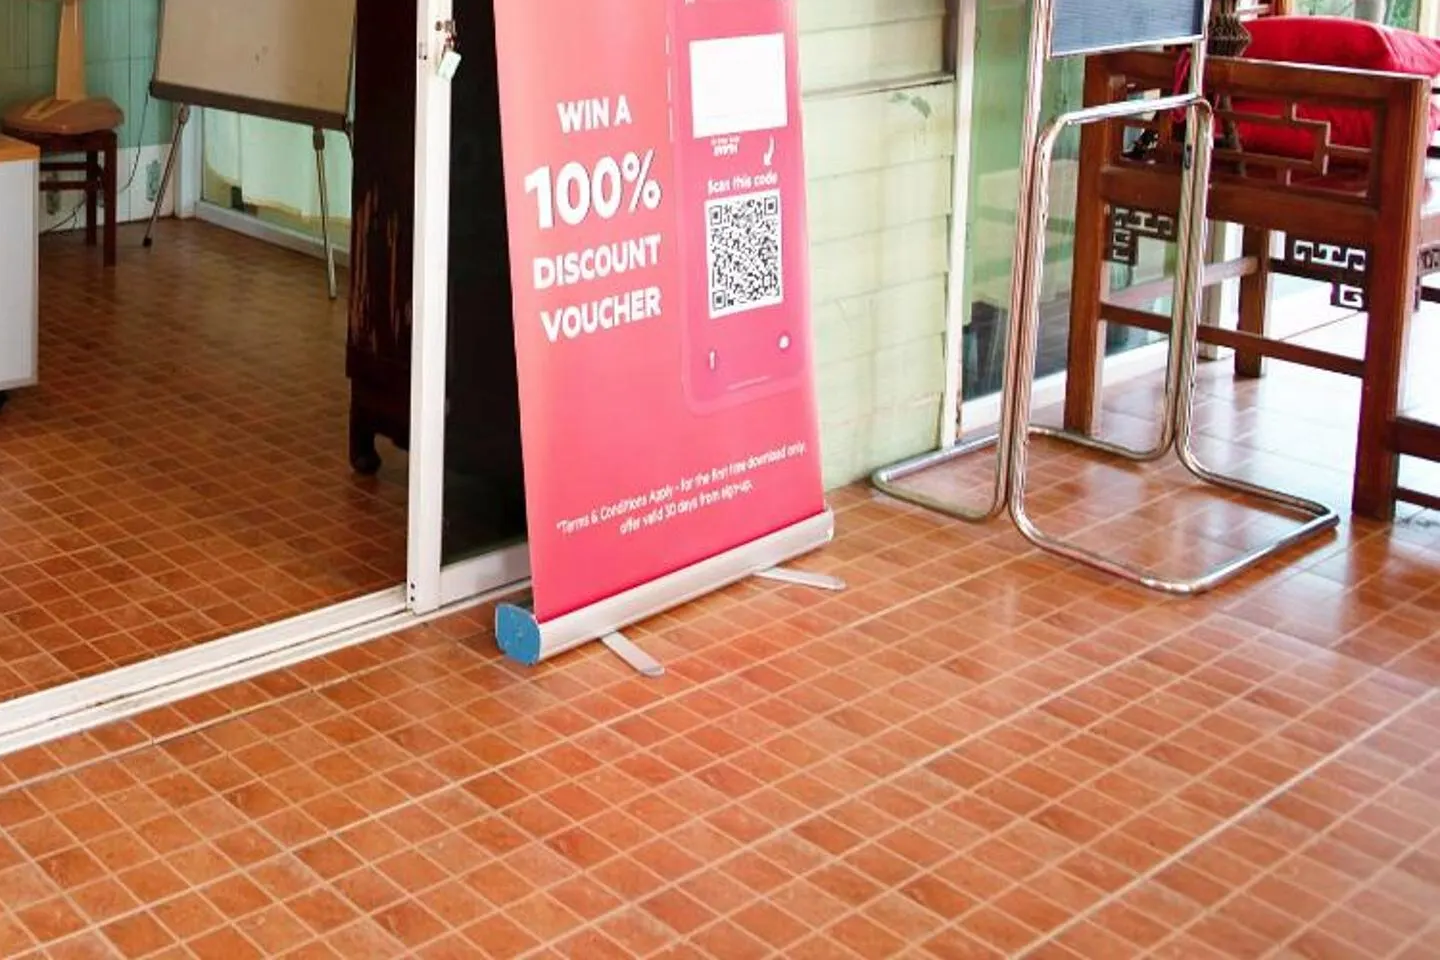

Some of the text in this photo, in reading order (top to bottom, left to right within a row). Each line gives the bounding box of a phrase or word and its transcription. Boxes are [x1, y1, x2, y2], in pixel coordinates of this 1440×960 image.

[557, 95, 632, 133] WIN A
[524, 148, 662, 230] 100%
[533, 234, 662, 290] DISCOUNT
[540, 287, 662, 344] VOUCHER
